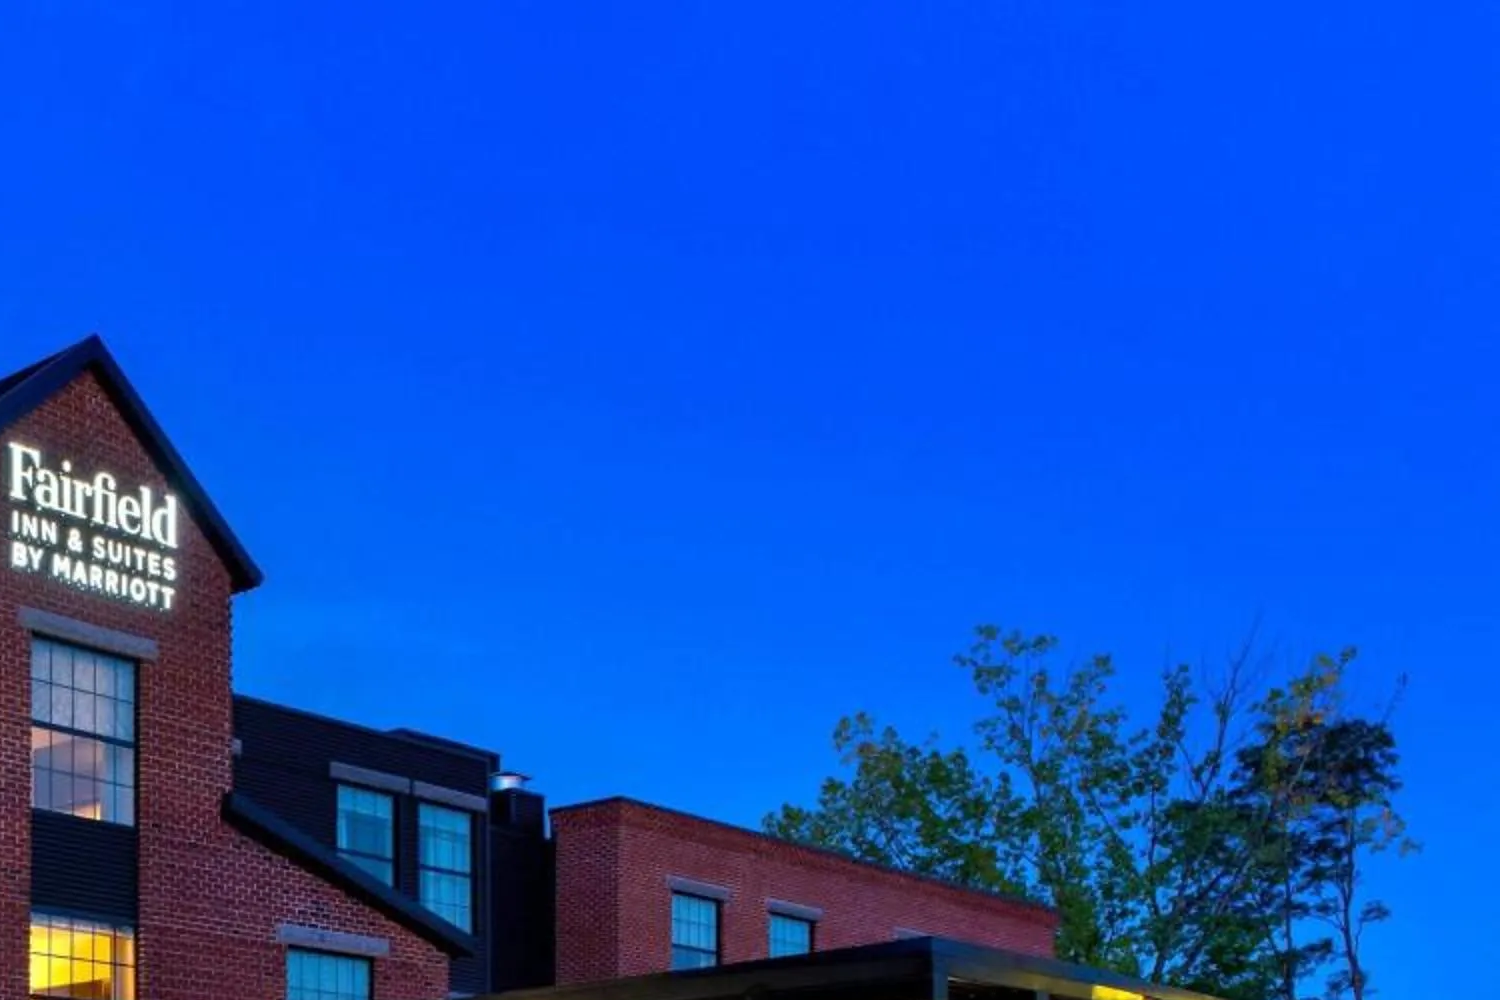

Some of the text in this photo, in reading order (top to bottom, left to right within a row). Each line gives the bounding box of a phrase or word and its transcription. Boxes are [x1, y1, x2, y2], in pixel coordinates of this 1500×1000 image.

[8, 441, 178, 548] Fairfield
[11, 510, 176, 580] INN & SUITES
[11, 542, 175, 609] BY MARRIOTT
